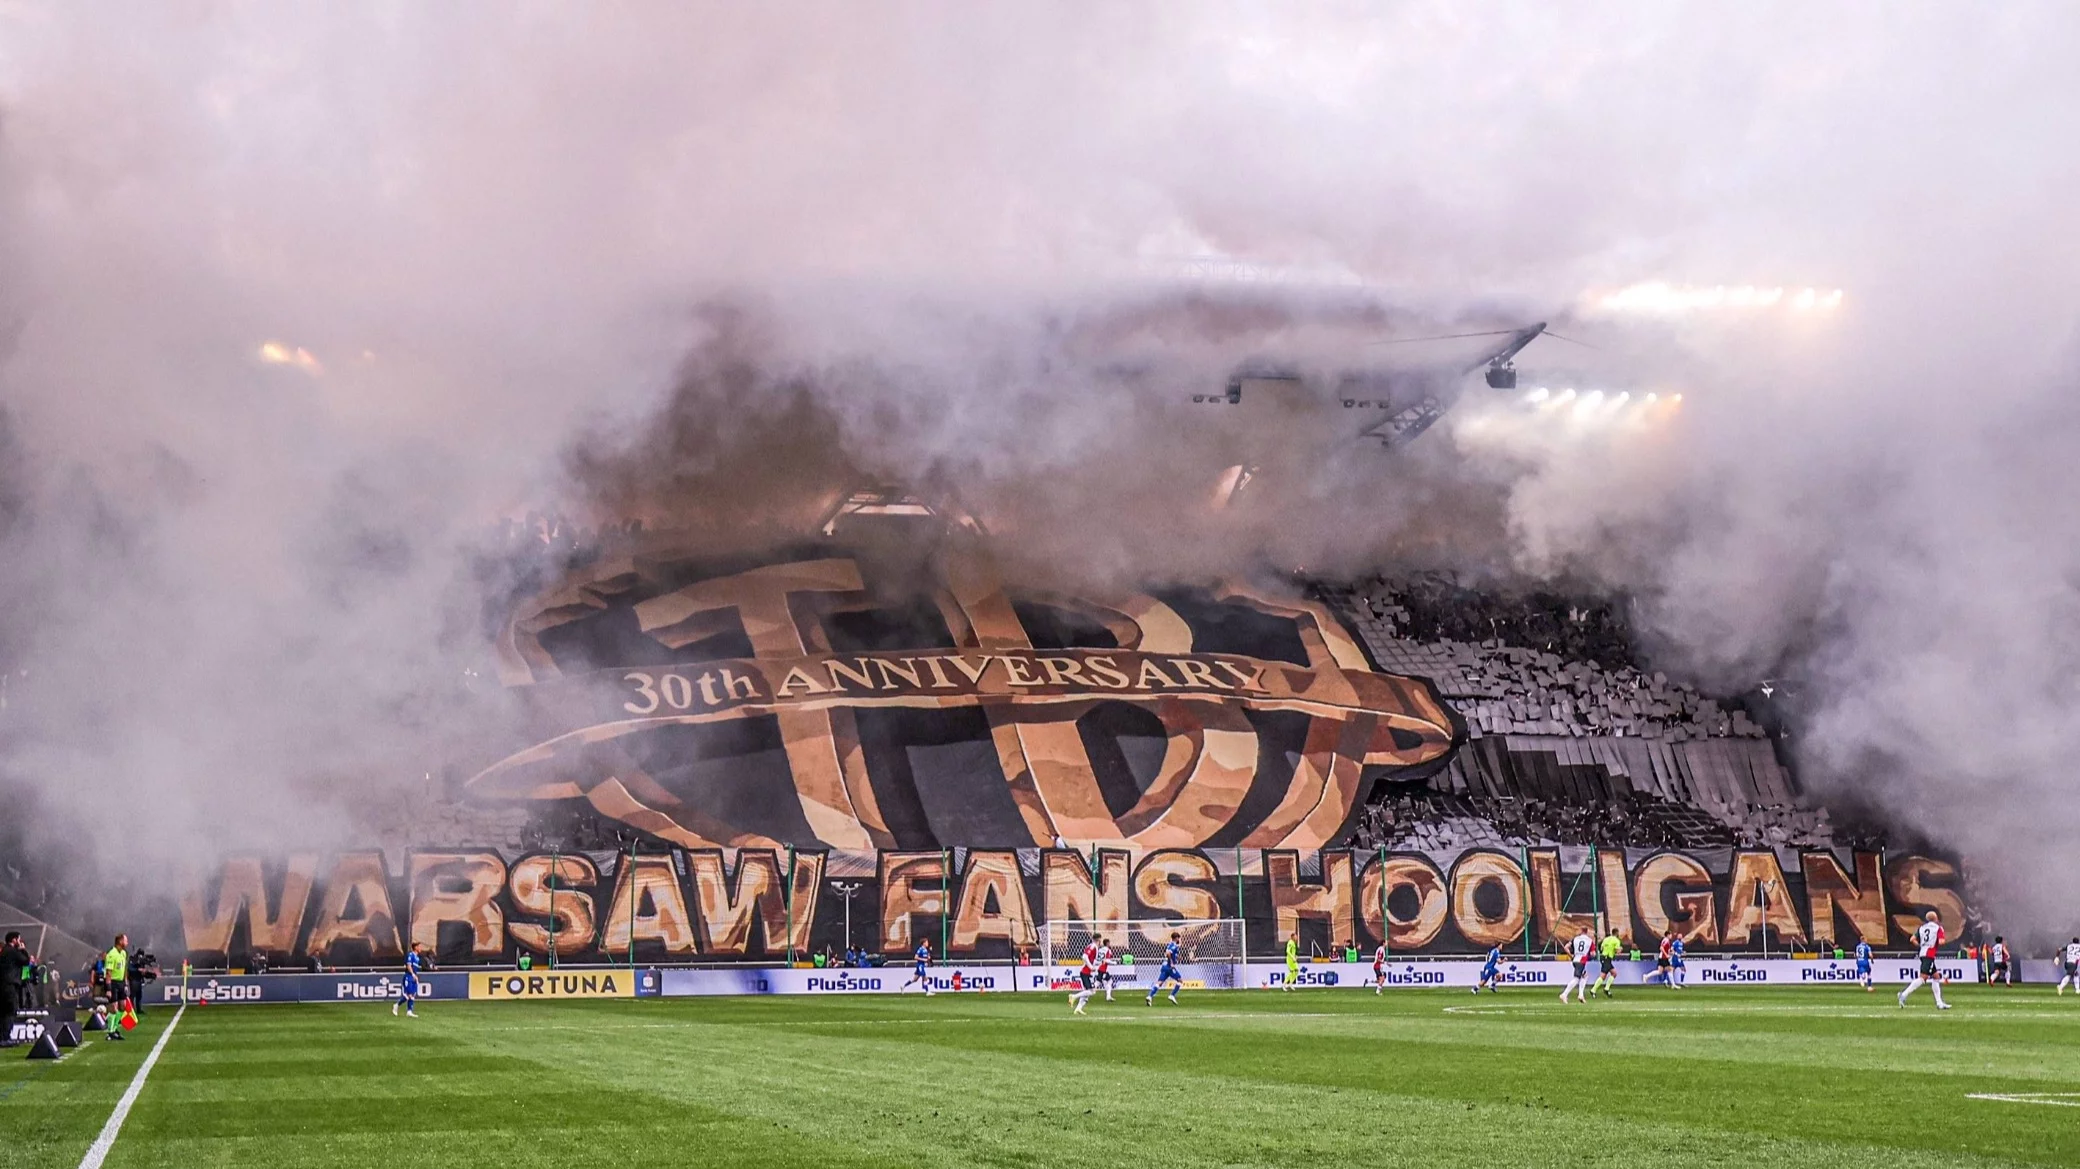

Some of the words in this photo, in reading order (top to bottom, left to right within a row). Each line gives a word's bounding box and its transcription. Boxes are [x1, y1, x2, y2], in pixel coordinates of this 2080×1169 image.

[624, 667, 762, 714] 30th
[776, 655, 1272, 698] ANNIVERSARY
[178, 848, 826, 957] WARSAW
[878, 847, 1224, 954] FANS
[1262, 846, 1966, 949] HOOLIGANS
[1923, 928, 1931, 943] 3
[1578, 941, 1586, 953] 8
[1701, 968, 1768, 982] Plus500
[337, 982, 432, 998] Plus50
[487, 974, 617, 995] FORTUNA
[807, 976, 882, 991] Plus500
